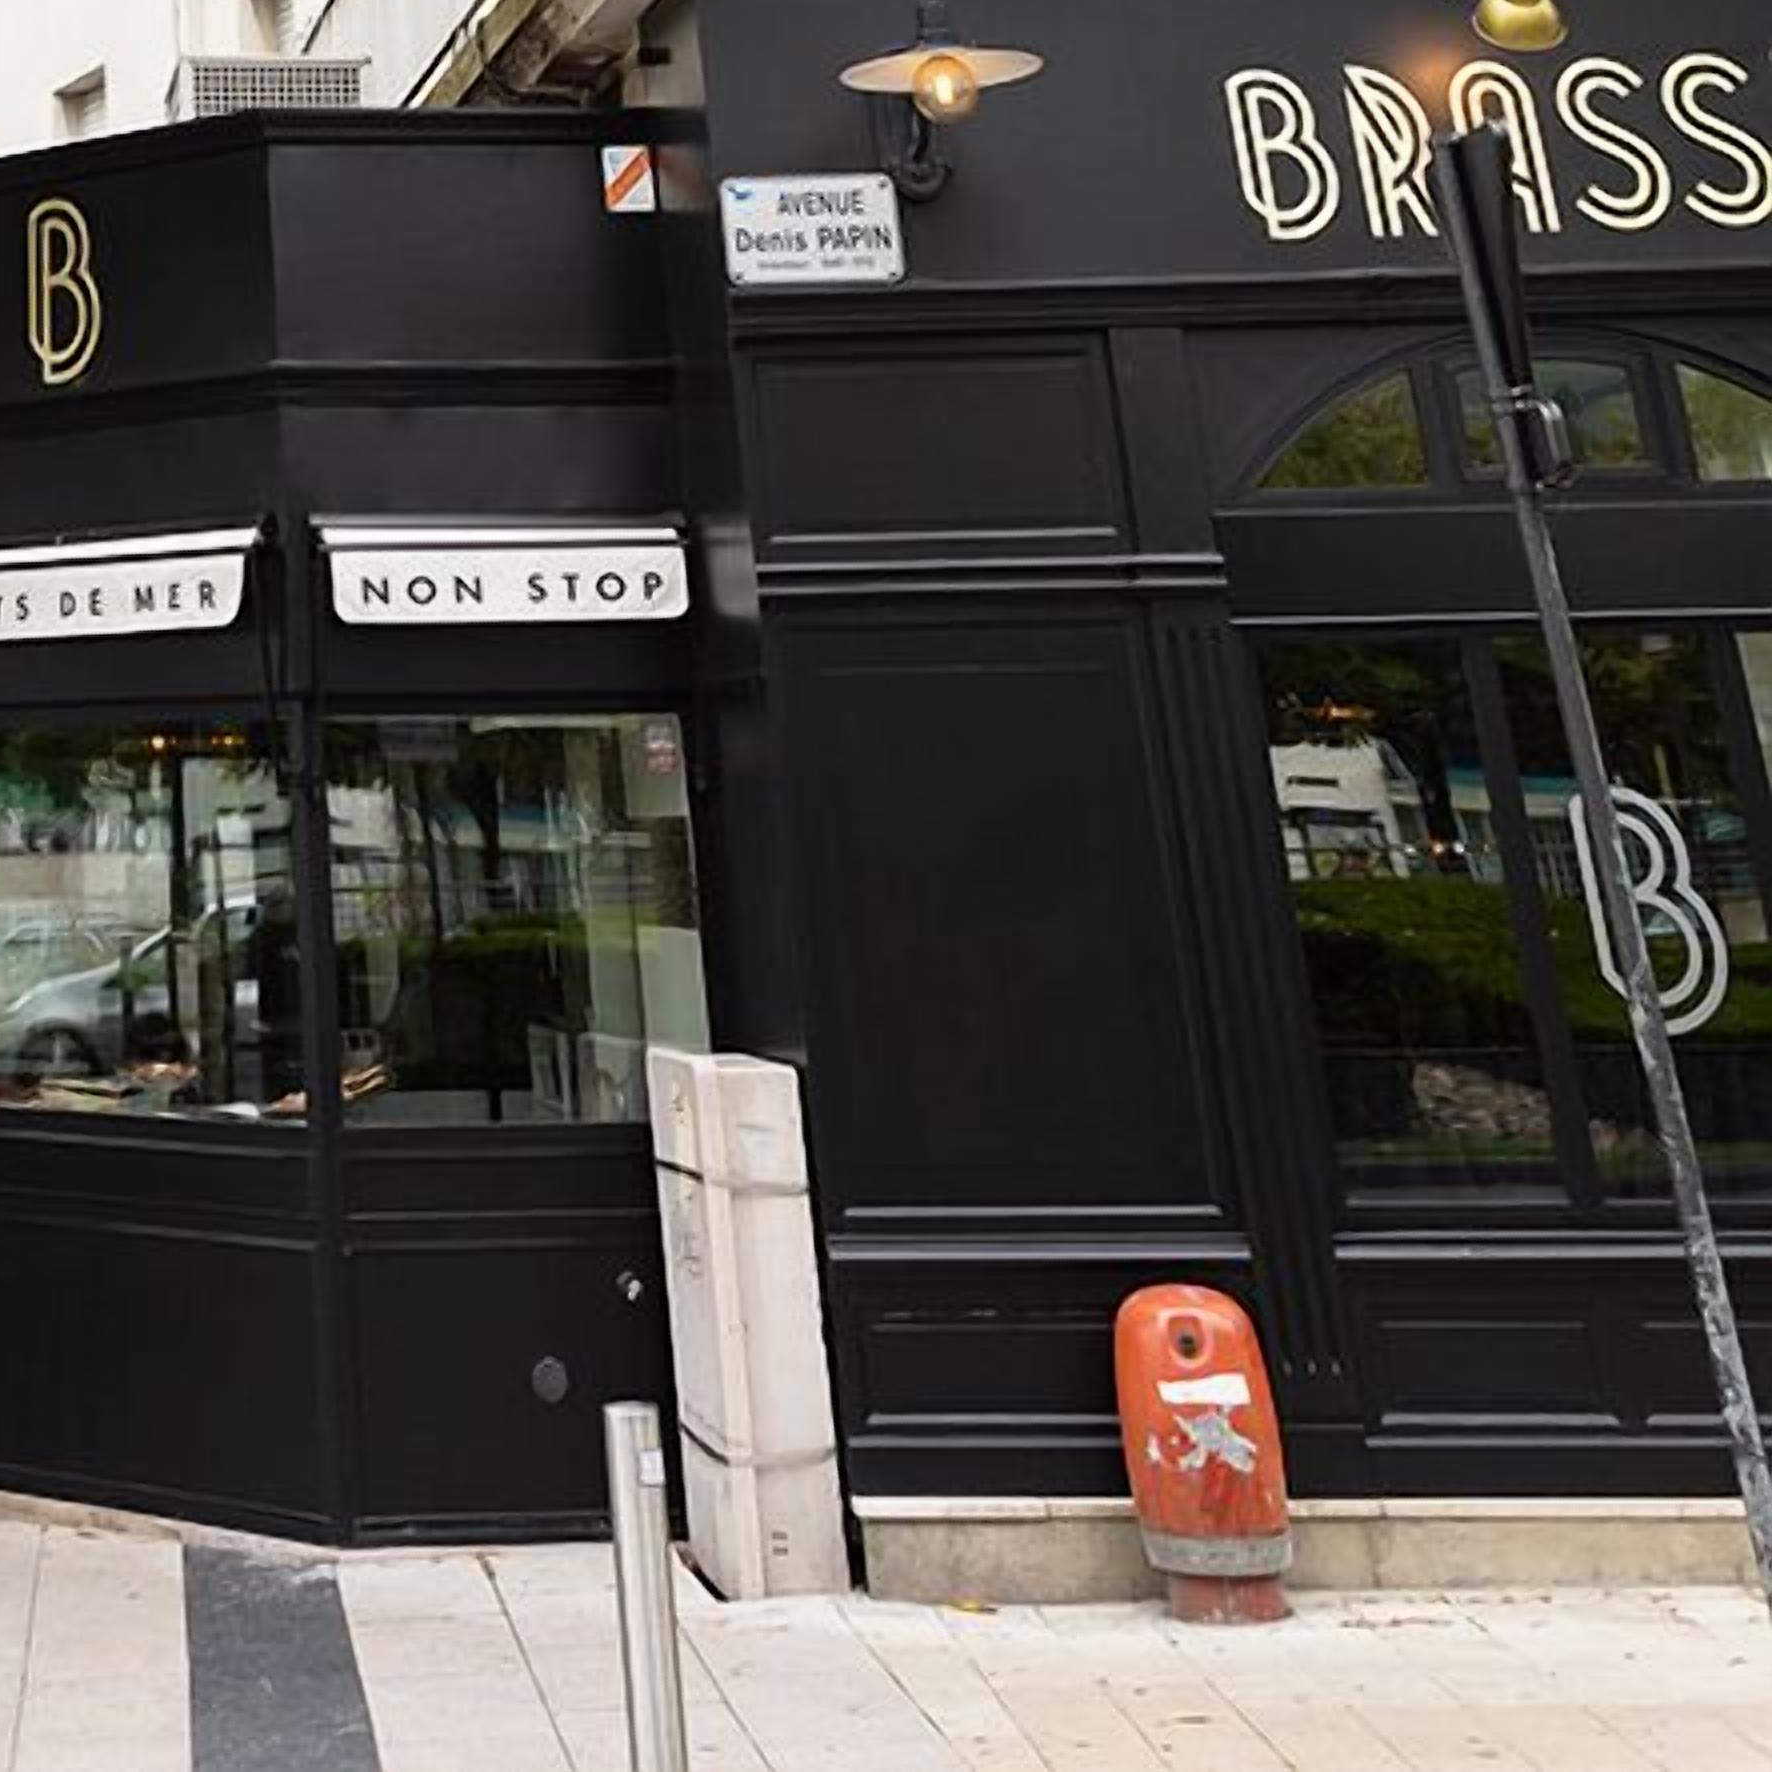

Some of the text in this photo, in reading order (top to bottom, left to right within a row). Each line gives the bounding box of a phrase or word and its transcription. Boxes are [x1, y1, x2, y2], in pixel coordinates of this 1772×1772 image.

[777, 188, 865, 216] AVENUE
[735, 224, 892, 252] Denis PAPIN
[28, 197, 102, 384] B
[59, 587, 104, 618] DE
[134, 579, 216, 612] MER
[361, 572, 663, 605] NON STOP
[1568, 785, 1728, 1037] B
